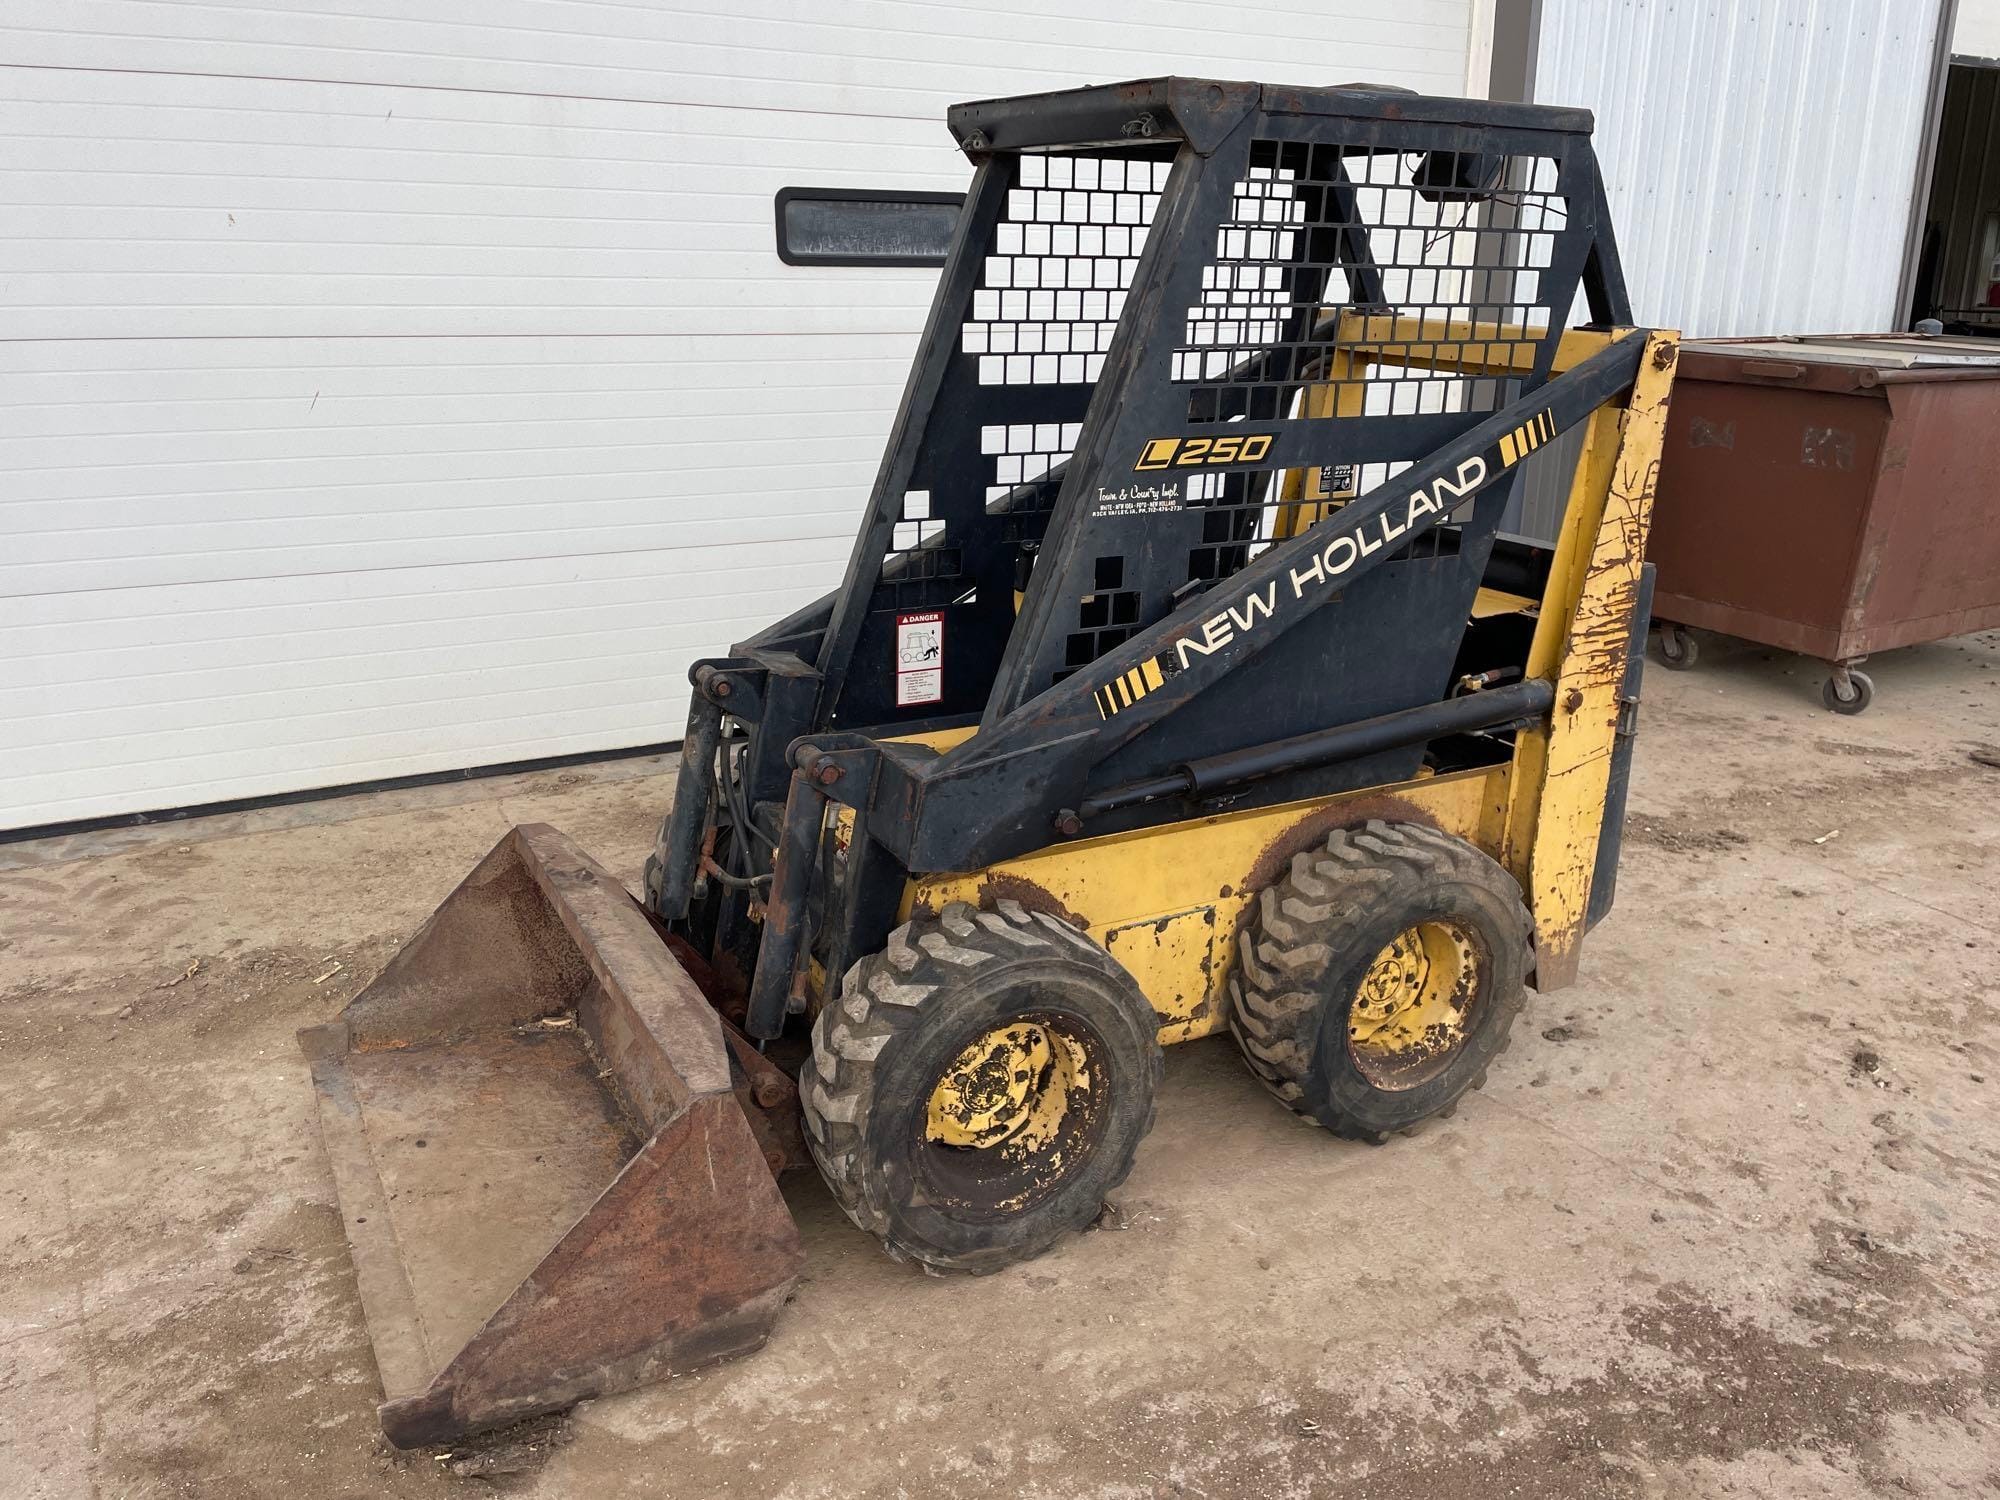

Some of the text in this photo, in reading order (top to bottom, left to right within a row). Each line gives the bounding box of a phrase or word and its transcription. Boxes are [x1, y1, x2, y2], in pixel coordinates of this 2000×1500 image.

[1098, 487, 1117, 502] Town
[1119, 488, 1128, 501] &
[1130, 484, 1160, 501] Country
[1175, 456, 1487, 670] NEW HOLLAND
[909, 613, 939, 623] DANGER
